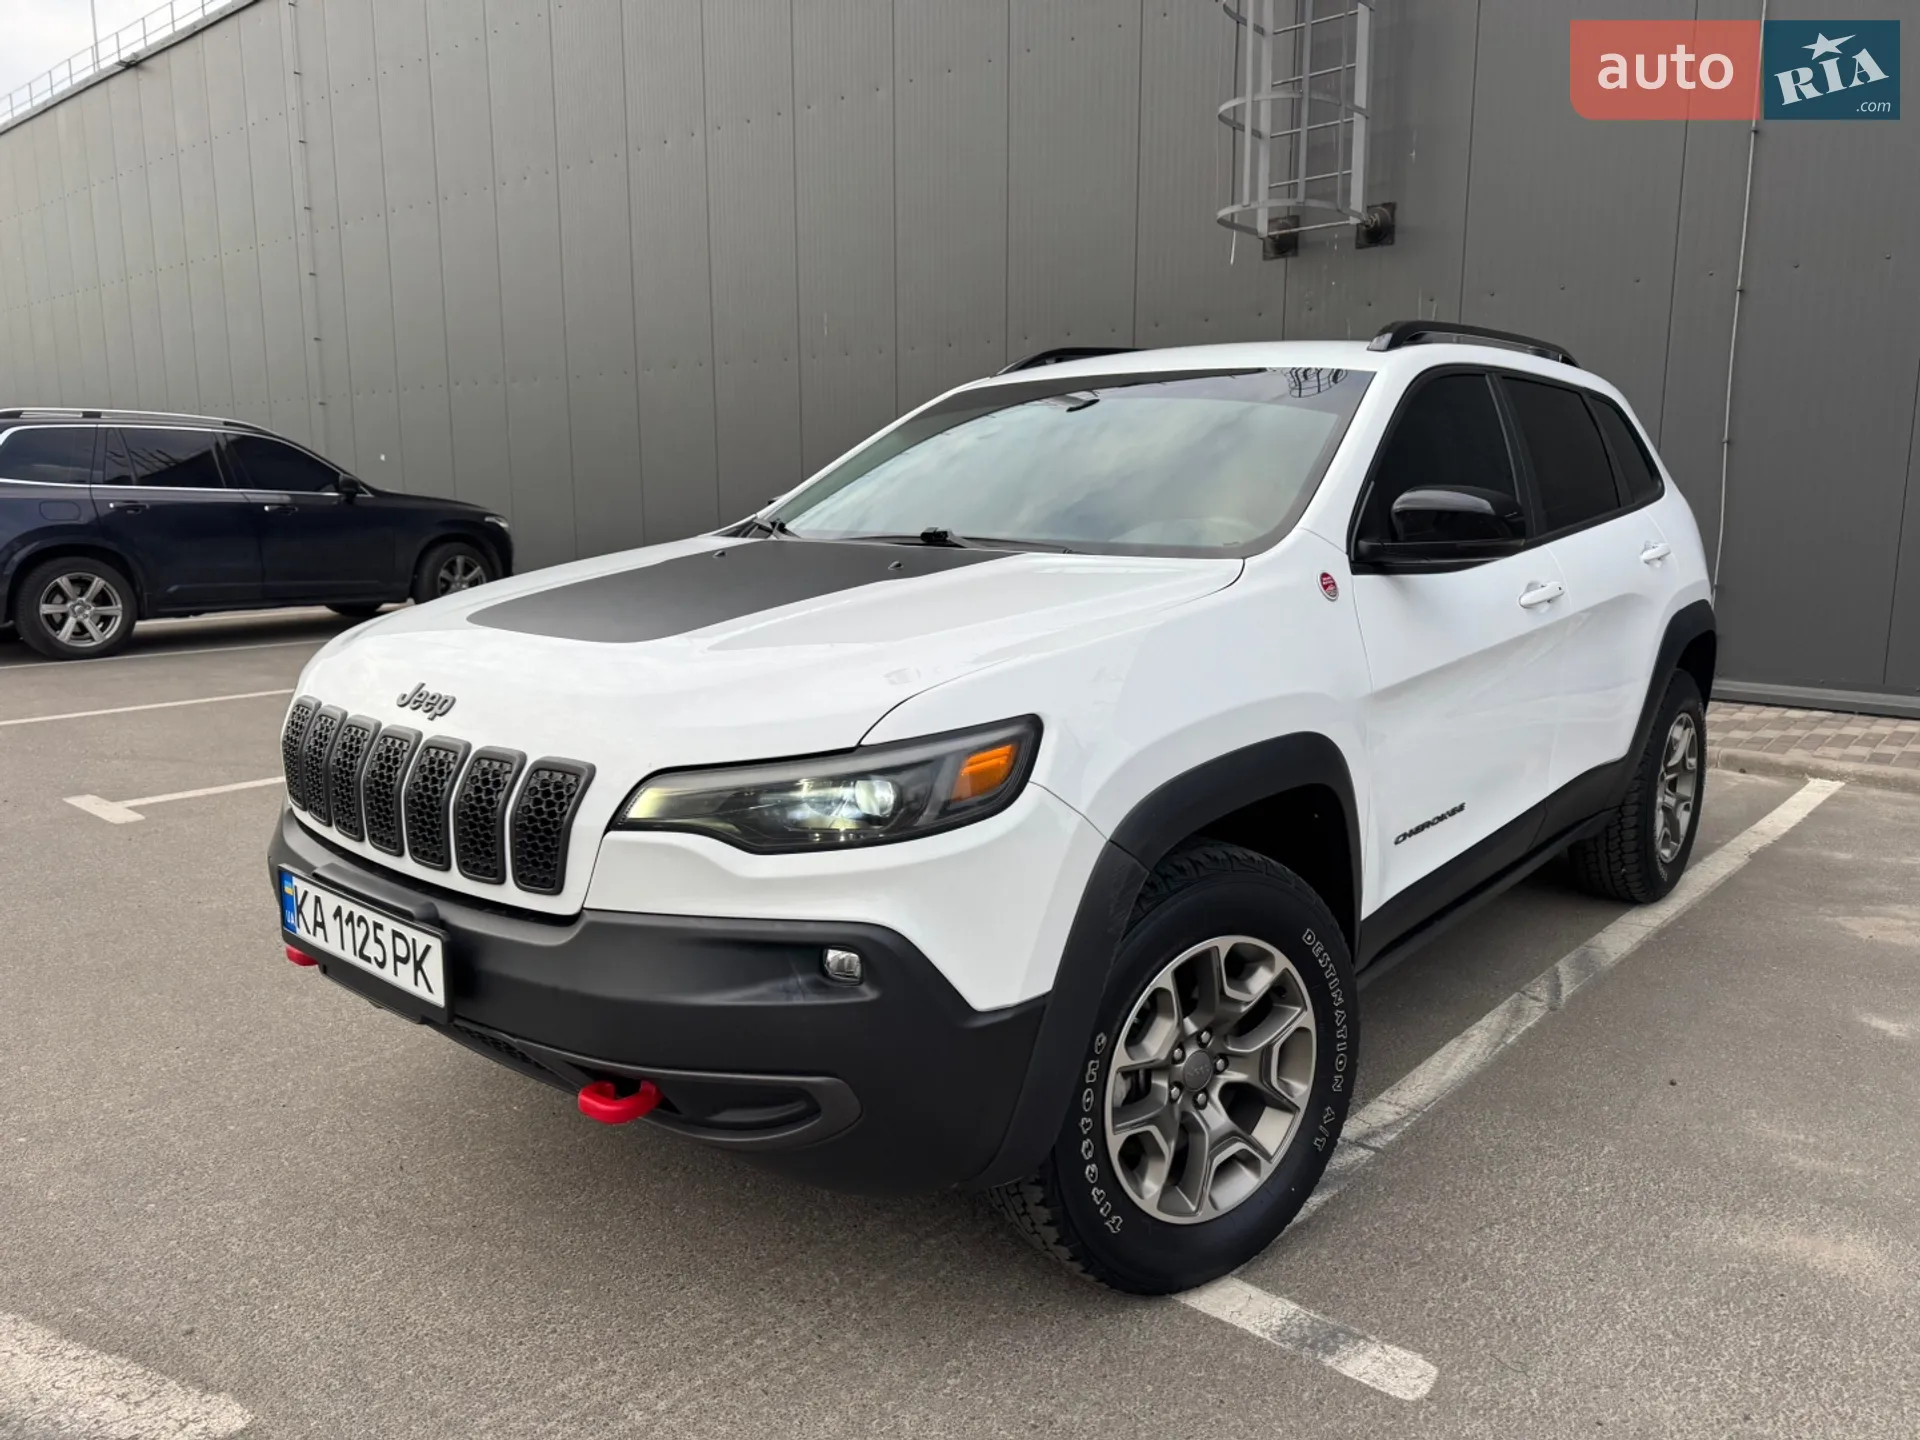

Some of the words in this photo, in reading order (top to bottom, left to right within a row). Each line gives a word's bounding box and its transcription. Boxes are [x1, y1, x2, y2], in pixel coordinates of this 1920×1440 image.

[396, 682, 457, 721] Jeep
[1394, 802, 1466, 845] CHEROKEE
[294, 885, 329, 943] KA
[333, 904, 387, 970] 1125
[391, 928, 434, 995] PK
[1301, 928, 1347, 1092] DESTINATION
[1313, 1106, 1336, 1151] A/T
